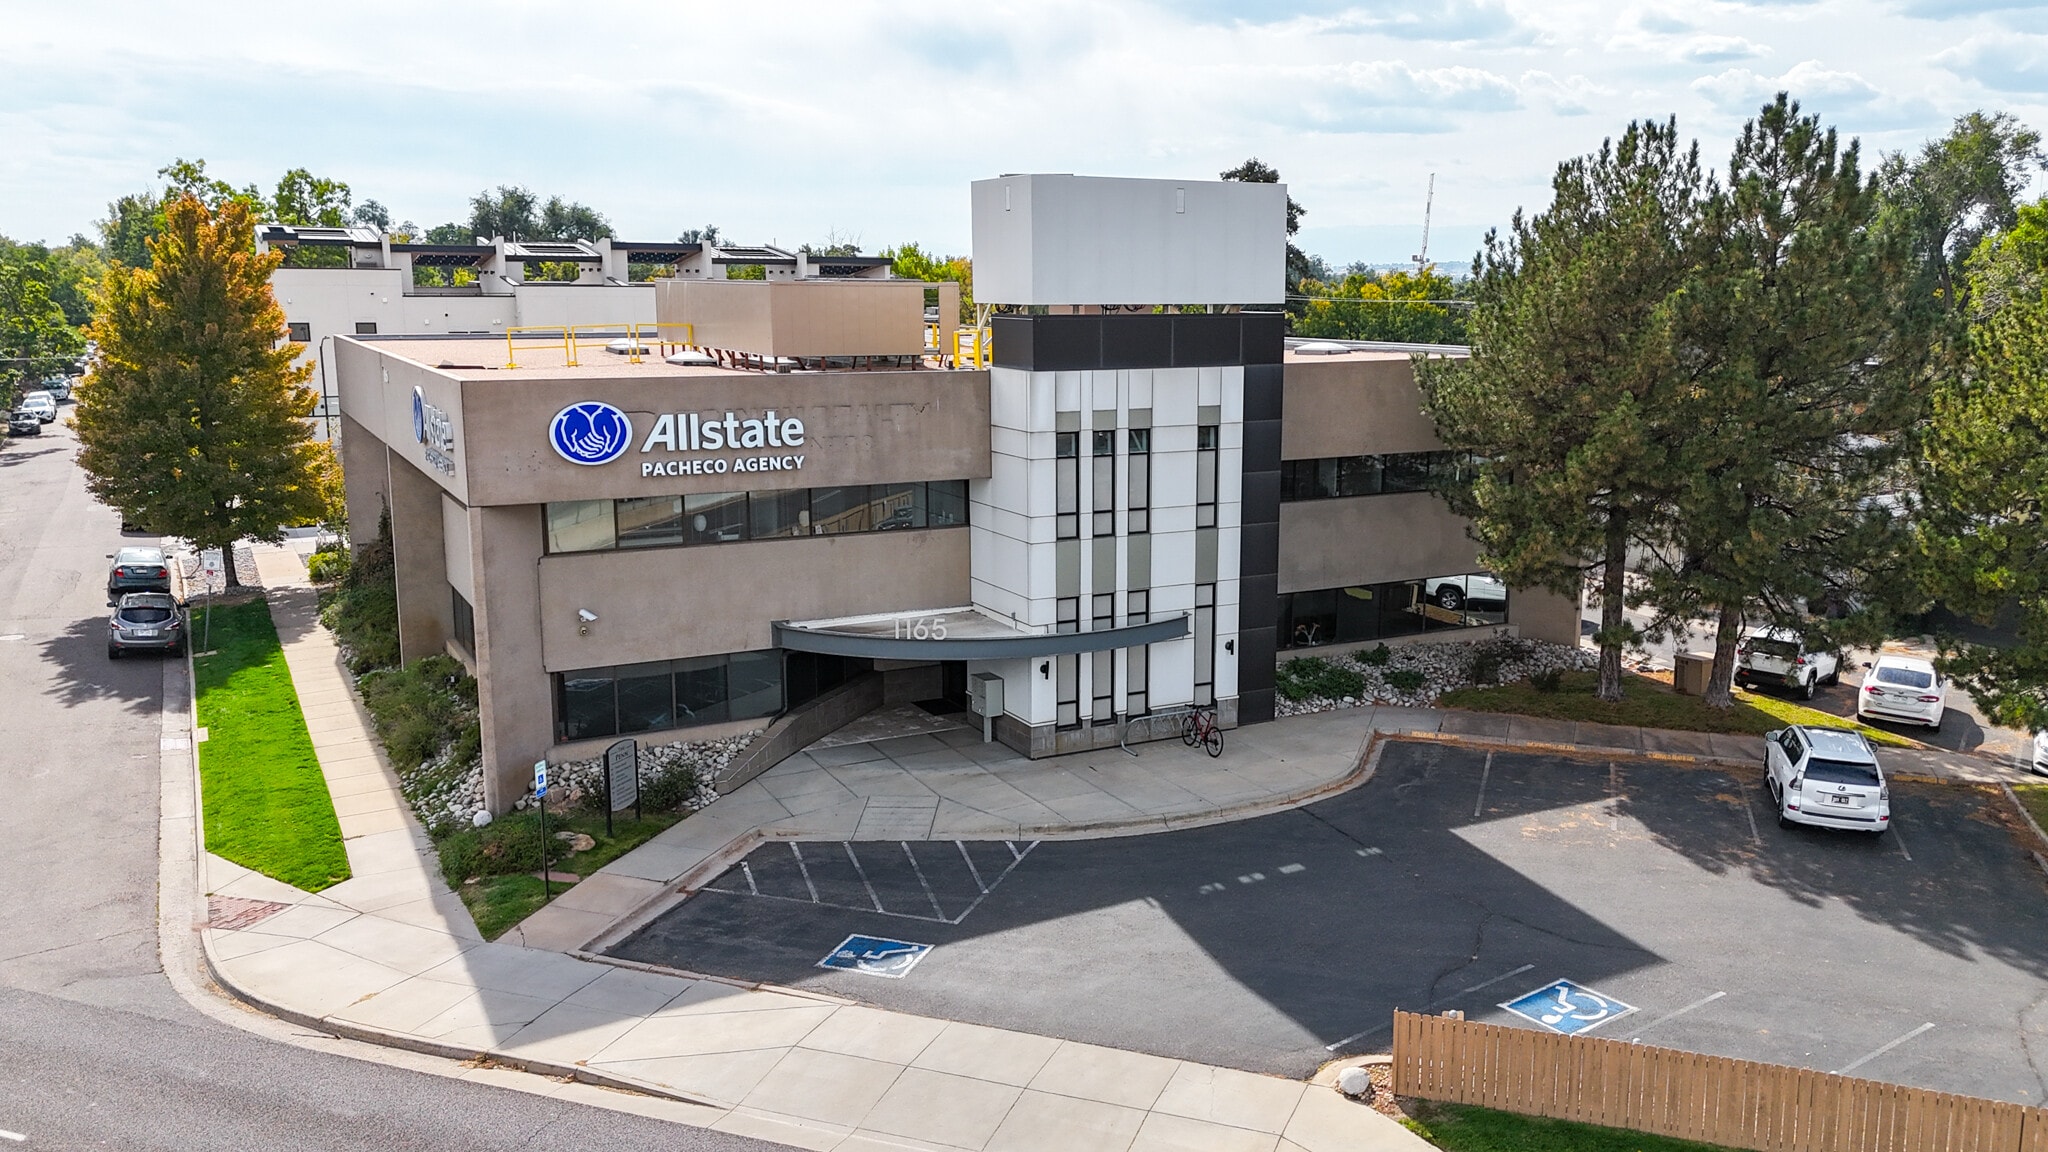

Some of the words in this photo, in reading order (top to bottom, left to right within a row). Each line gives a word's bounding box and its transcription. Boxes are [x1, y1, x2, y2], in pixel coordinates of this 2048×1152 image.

[641, 411, 805, 452] Allstate
[641, 459, 728, 477] PACHECO
[733, 455, 805, 473] AGENCY
[895, 618, 947, 640] 1165
